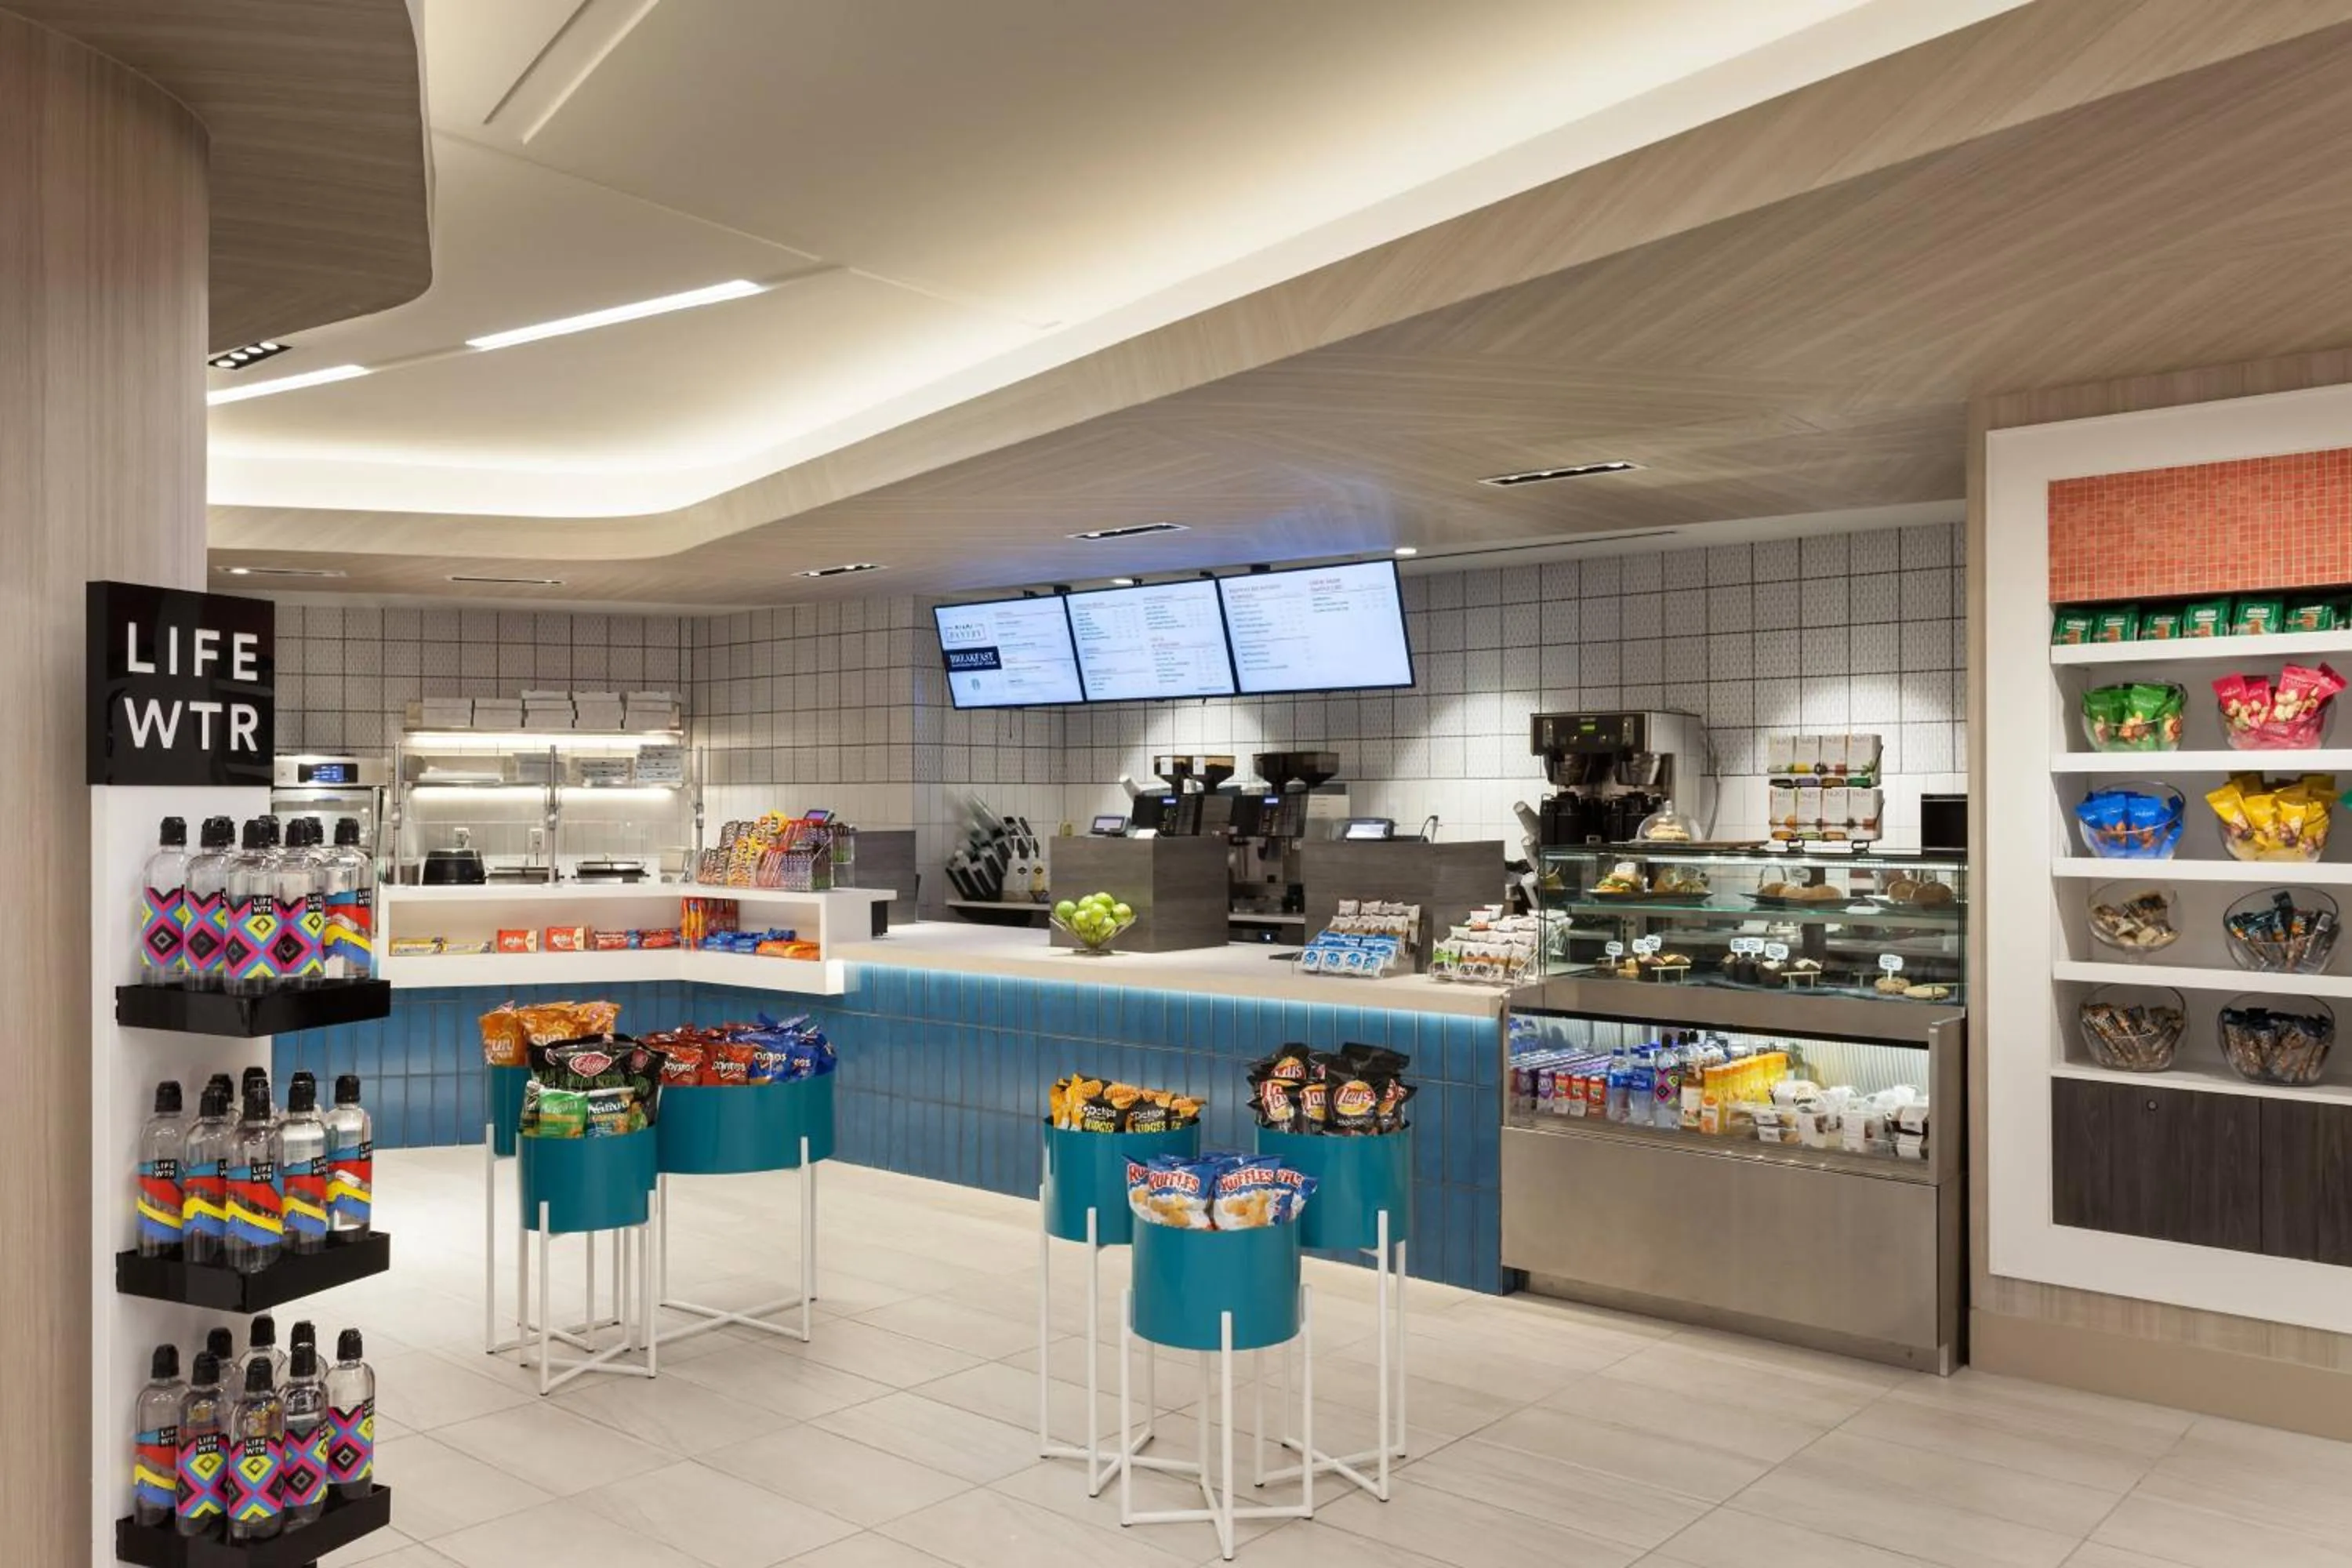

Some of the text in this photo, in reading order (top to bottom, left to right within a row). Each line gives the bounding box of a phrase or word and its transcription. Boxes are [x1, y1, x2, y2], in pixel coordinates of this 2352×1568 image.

[127, 622, 259, 681] LIFE
[124, 697, 260, 752] WTR
[252, 896, 272, 906] LIFE
[252, 904, 272, 913] WTR
[155, 1163, 175, 1171] LIFE
[252, 1163, 273, 1174] LIFE
[252, 1173, 273, 1181] WTR
[1149, 1169, 1200, 1193] RUFFLES
[1220, 1165, 1275, 1193] RUFFLES
[245, 1437, 265, 1446] LIFE
[245, 1446, 266, 1455] WTR
